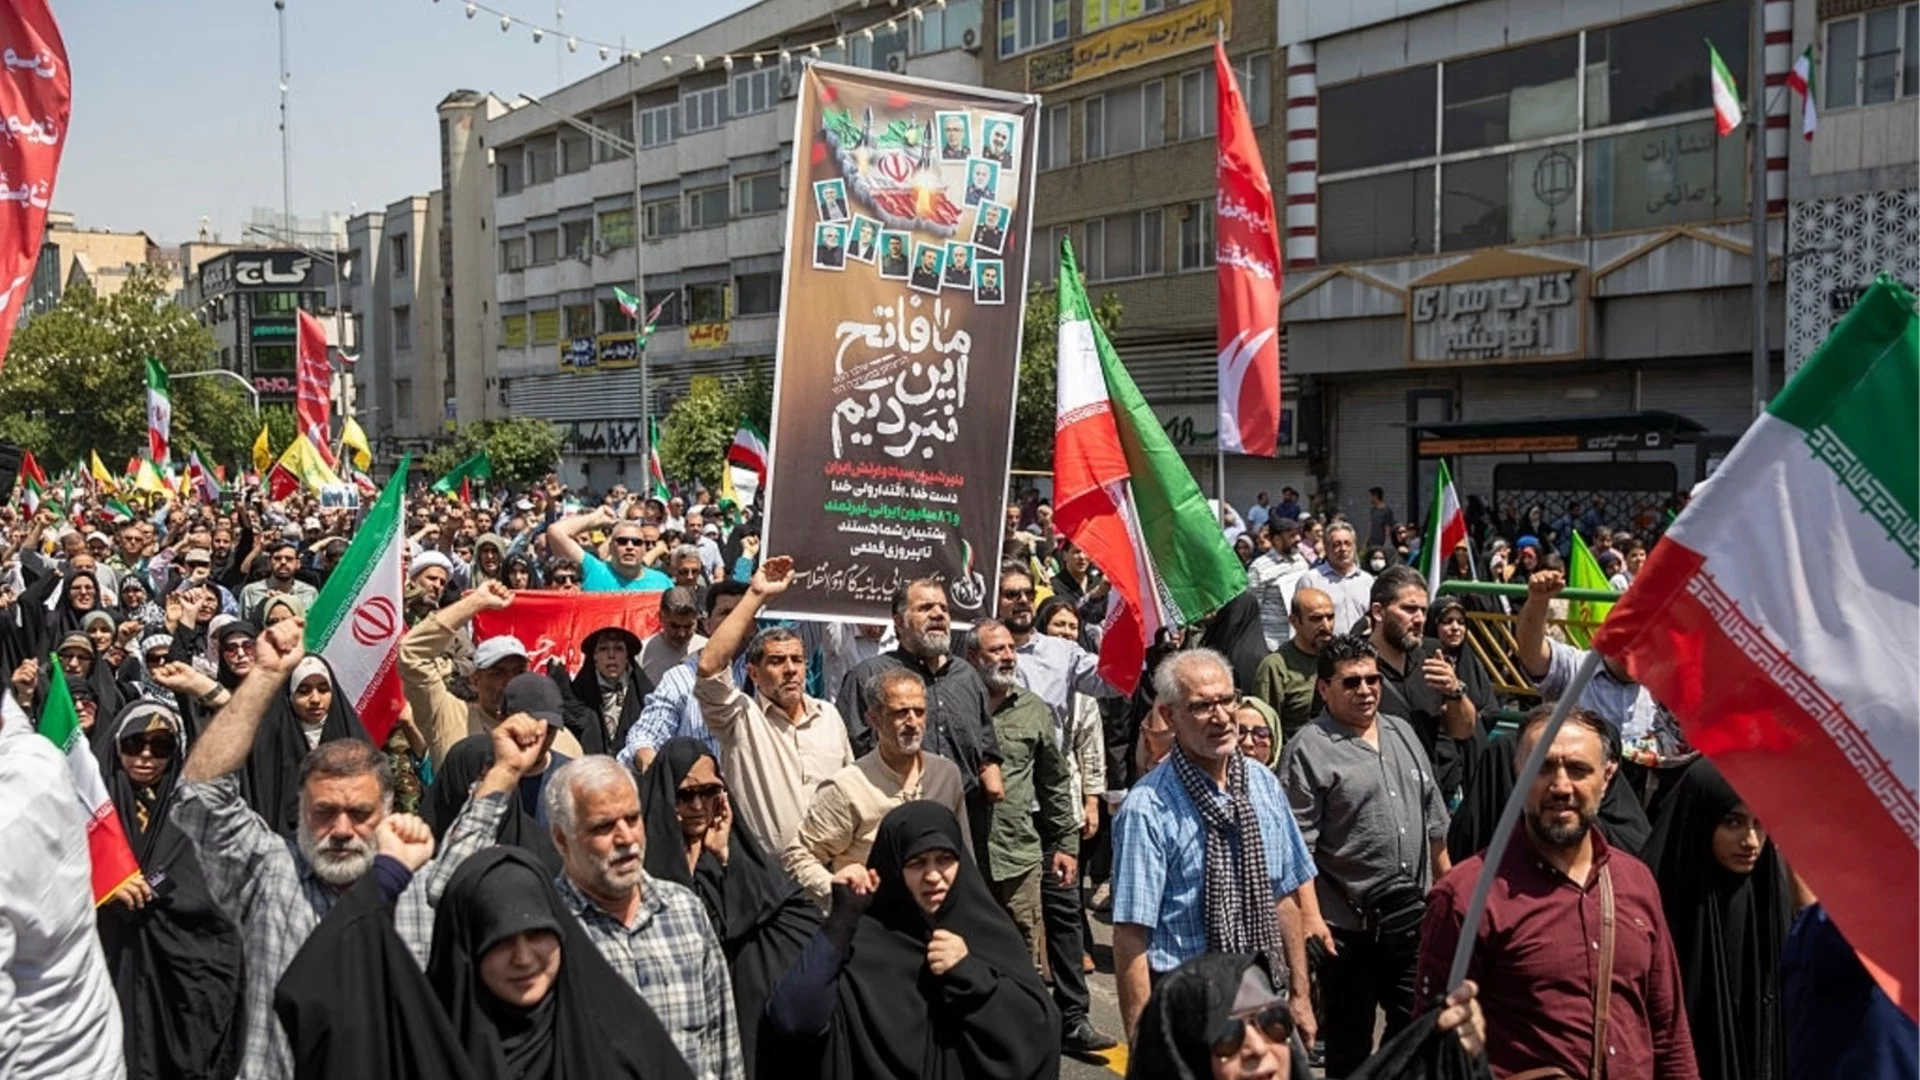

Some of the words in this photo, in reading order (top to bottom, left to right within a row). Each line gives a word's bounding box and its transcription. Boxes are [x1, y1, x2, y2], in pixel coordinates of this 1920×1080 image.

[236, 257, 312, 286] گاج
[835, 293, 931, 377] فاتح
[895, 353, 969, 409] این
[831, 479, 852, 492] خدا
[929, 490, 959, 504] دست
[837, 519, 880, 535] هستند
[880, 522, 902, 537] شما
[902, 525, 947, 545] پشتیبان
[850, 540, 885, 557] قطعی
